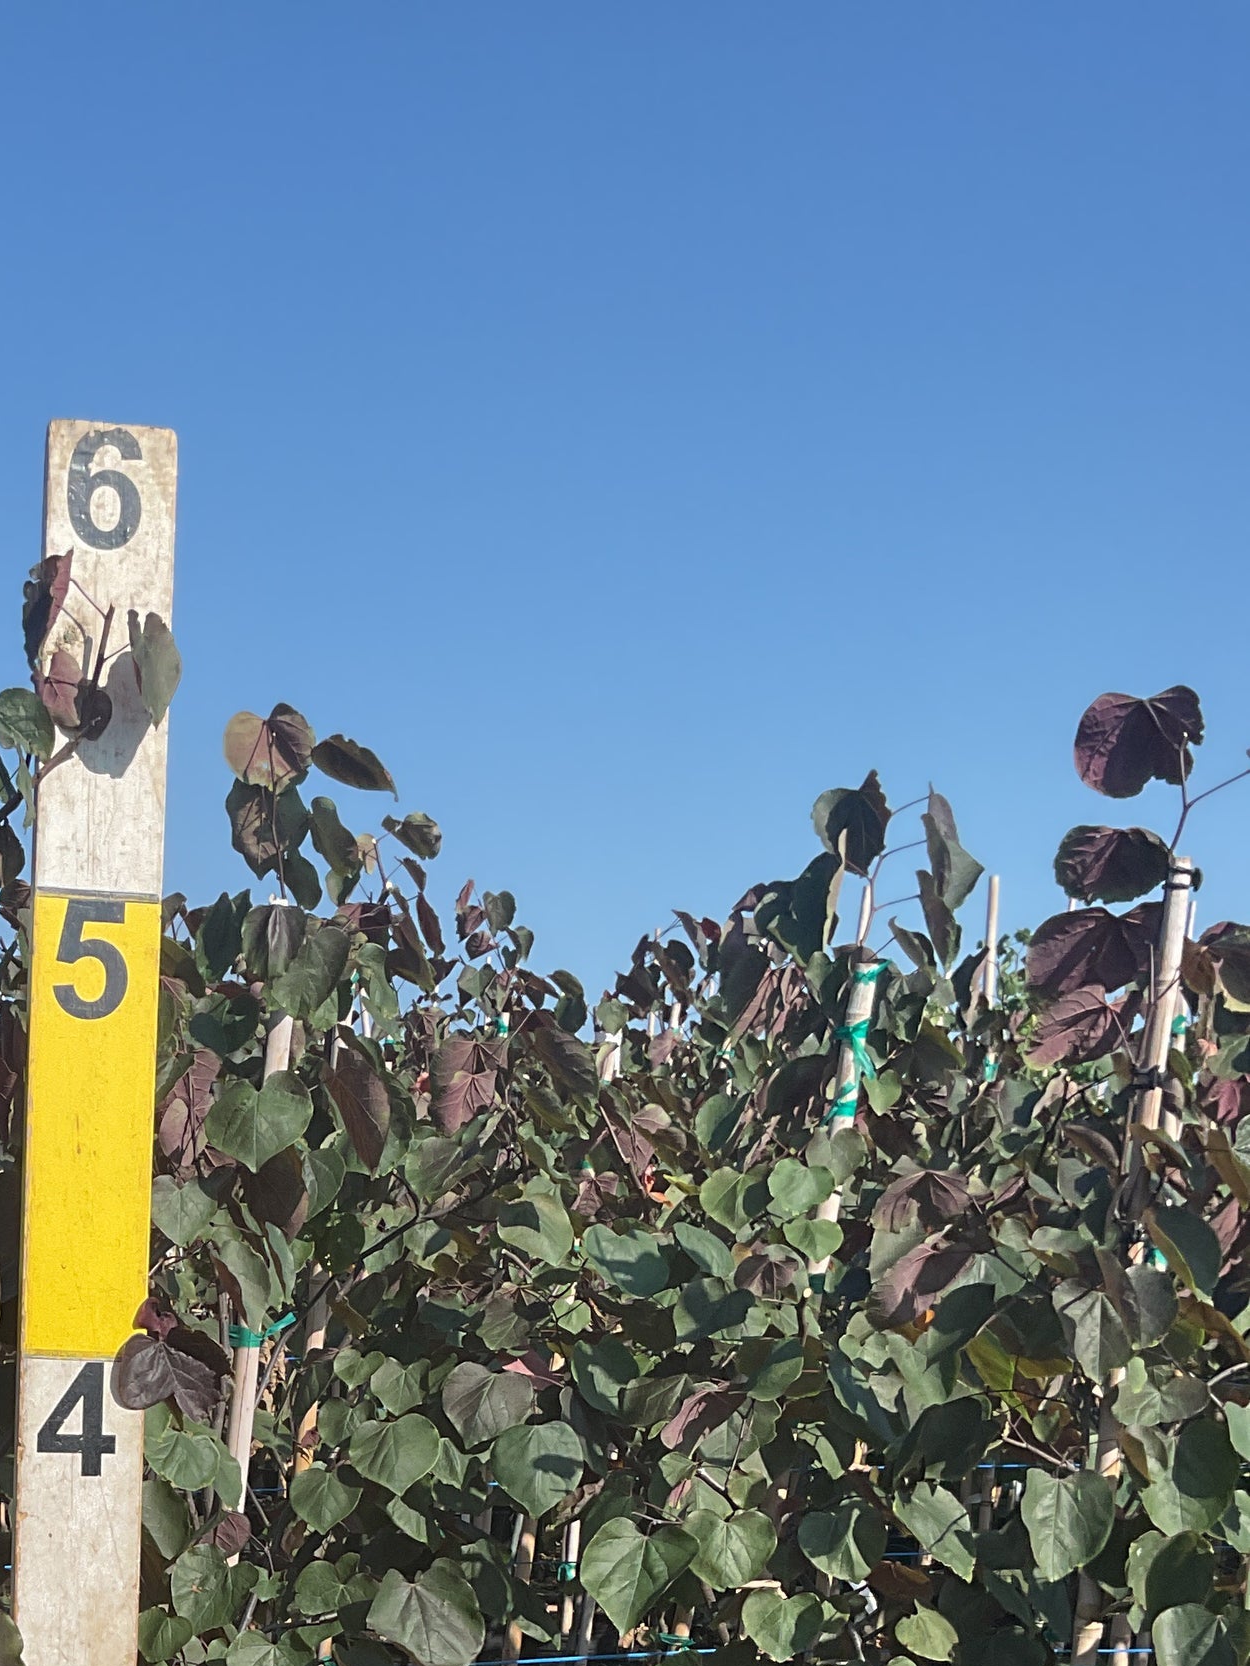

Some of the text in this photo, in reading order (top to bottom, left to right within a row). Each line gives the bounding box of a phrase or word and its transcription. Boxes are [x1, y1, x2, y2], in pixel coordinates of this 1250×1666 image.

[67, 427, 142, 550] 6
[53, 899, 128, 1020] 5
[37, 1362, 116, 1477] 4
